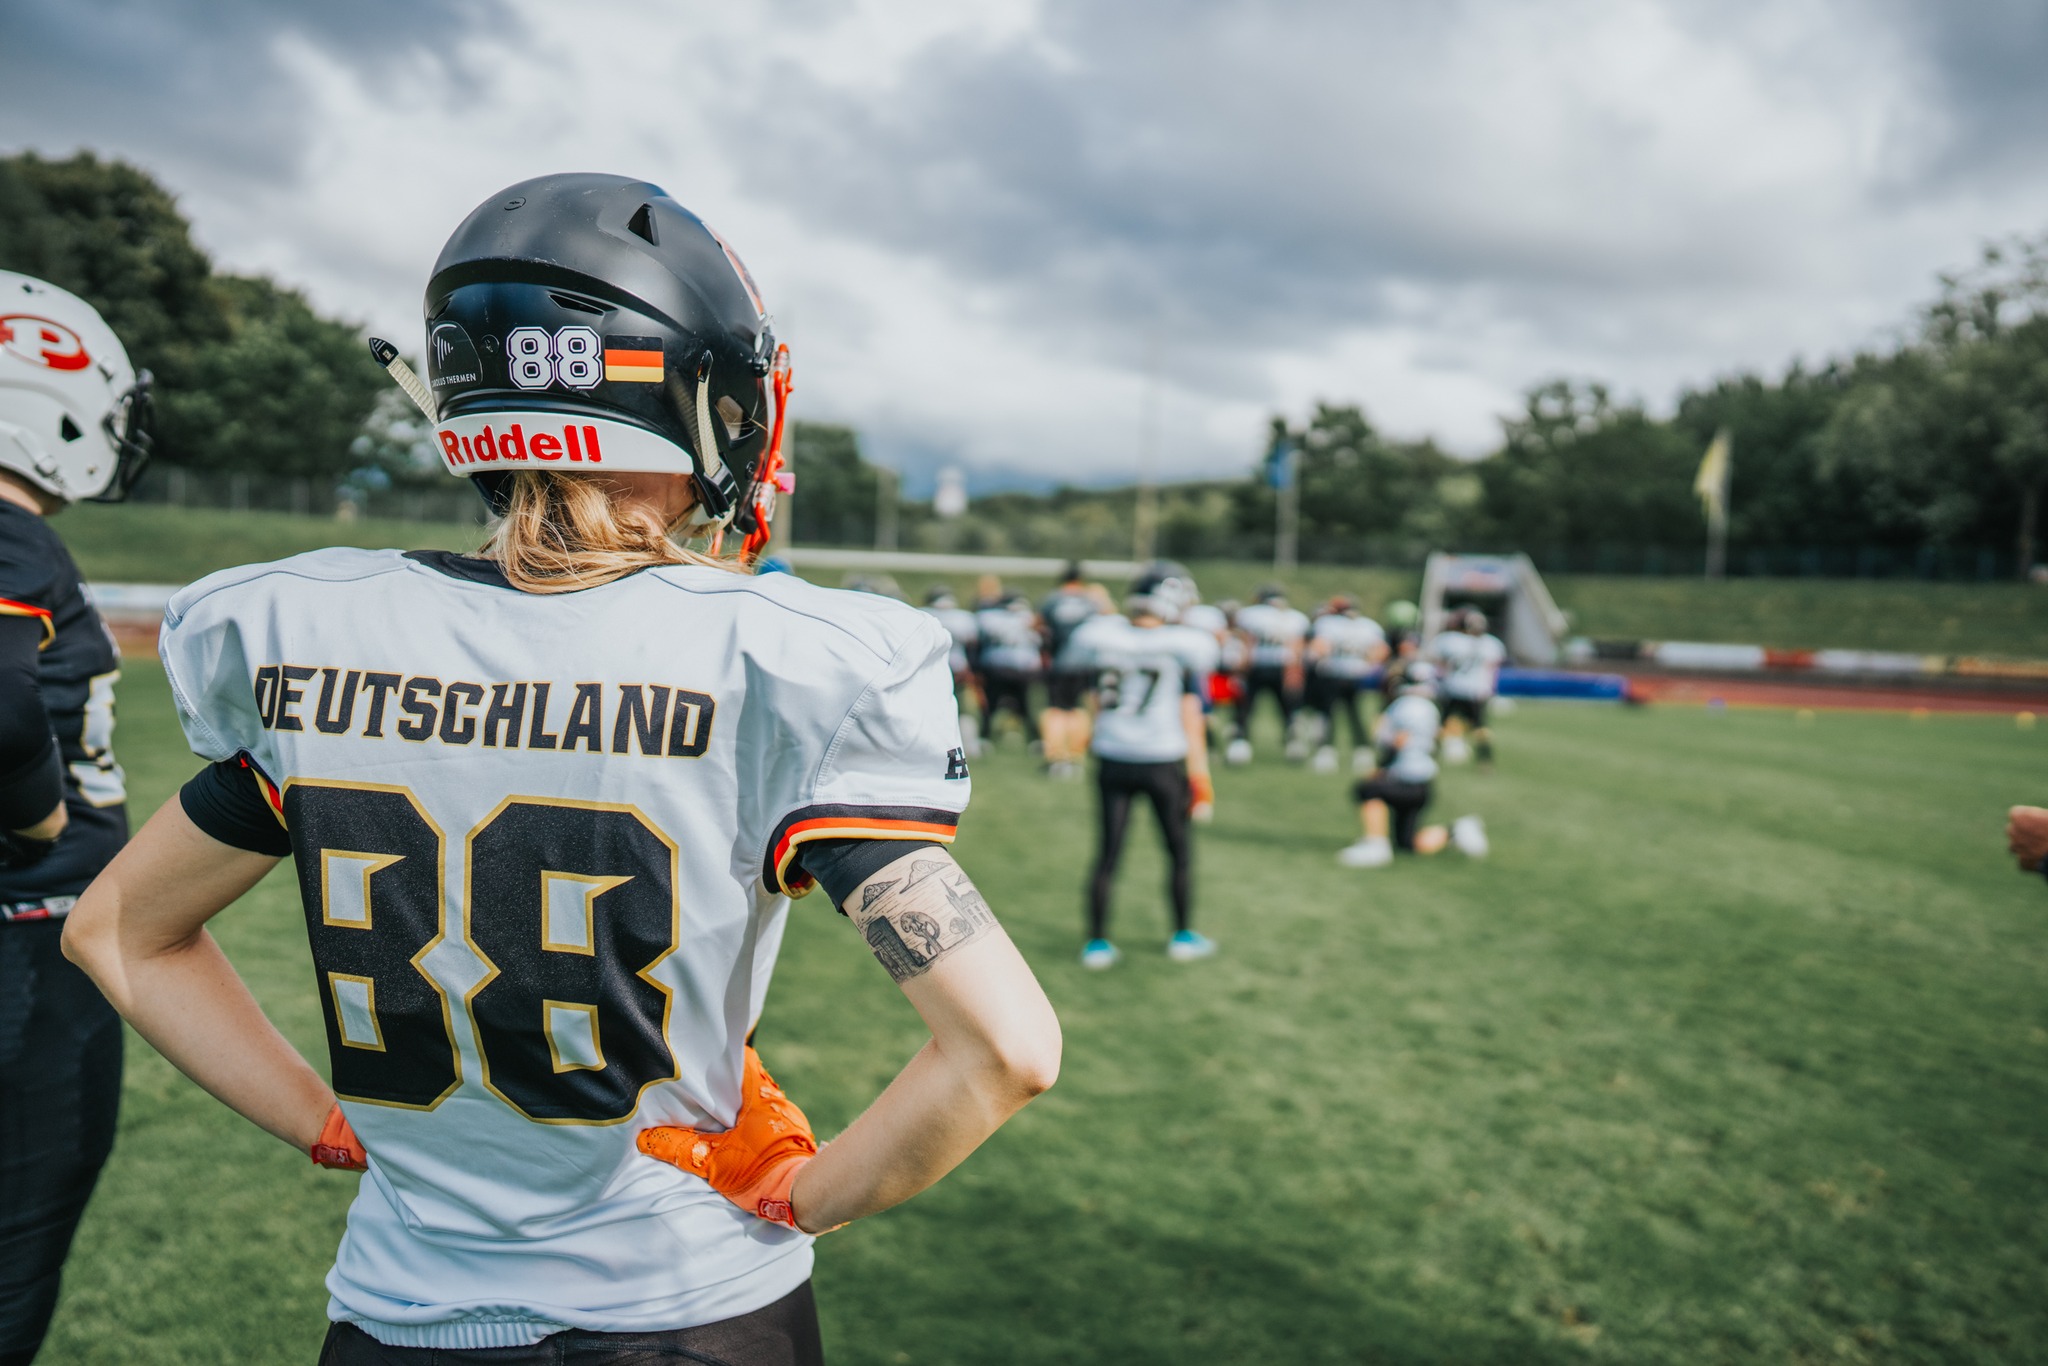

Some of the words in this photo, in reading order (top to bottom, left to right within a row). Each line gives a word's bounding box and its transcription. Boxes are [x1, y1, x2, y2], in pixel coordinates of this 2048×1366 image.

[446, 372, 477, 386] THERMEN
[506, 325, 603, 390] 88
[438, 424, 602, 466] Riddell
[255, 663, 716, 758] DEUTSCHLAND
[283, 776, 680, 1127] 88
